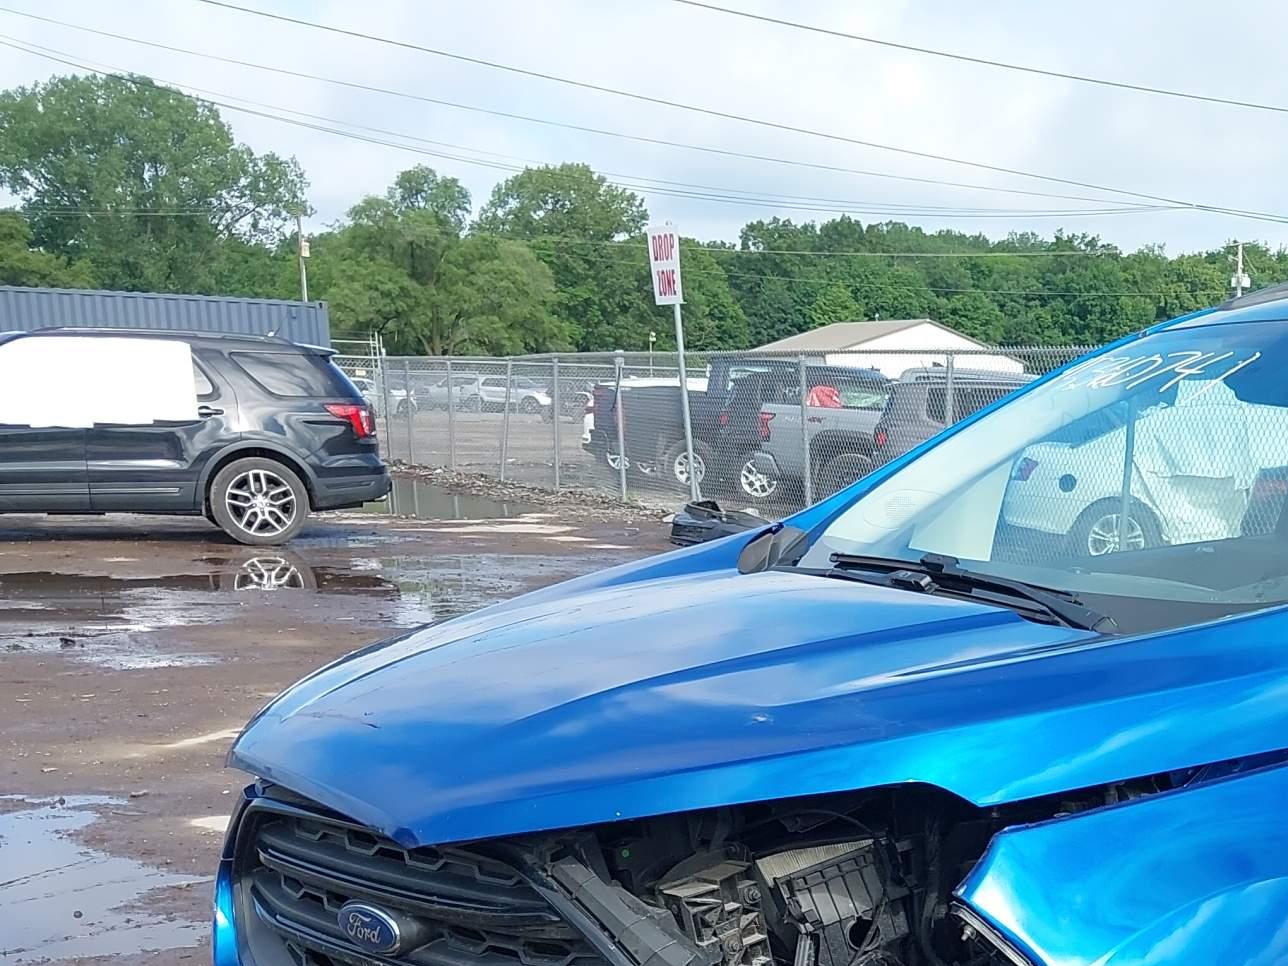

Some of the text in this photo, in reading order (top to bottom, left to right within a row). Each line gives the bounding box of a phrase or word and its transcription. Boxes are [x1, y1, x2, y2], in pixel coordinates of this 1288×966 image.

[652, 233, 675, 262] DROP
[656, 269, 677, 297] ZONE
[347, 912, 382, 944] Ford
